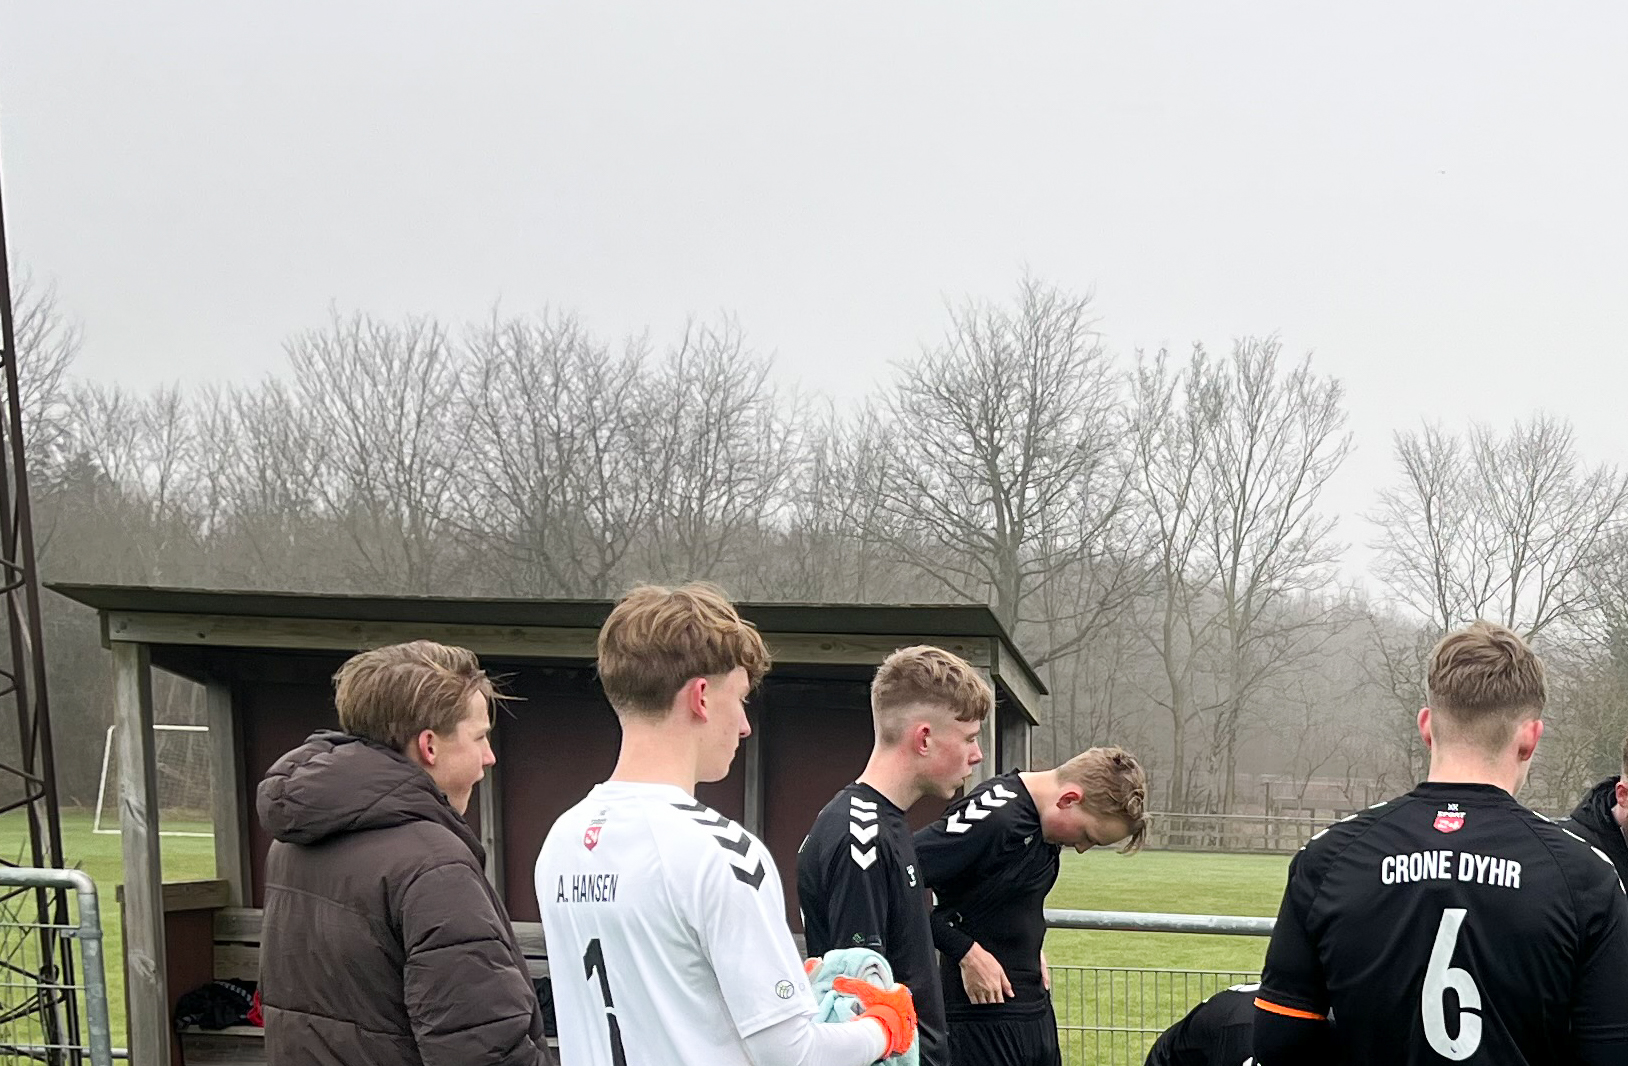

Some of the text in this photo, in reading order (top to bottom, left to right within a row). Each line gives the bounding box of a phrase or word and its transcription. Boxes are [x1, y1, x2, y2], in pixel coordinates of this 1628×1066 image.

[556, 873, 619, 903] A. HANSEN
[1381, 850, 1521, 889] CRONE DYHR
[1421, 908, 1482, 1061] 6
